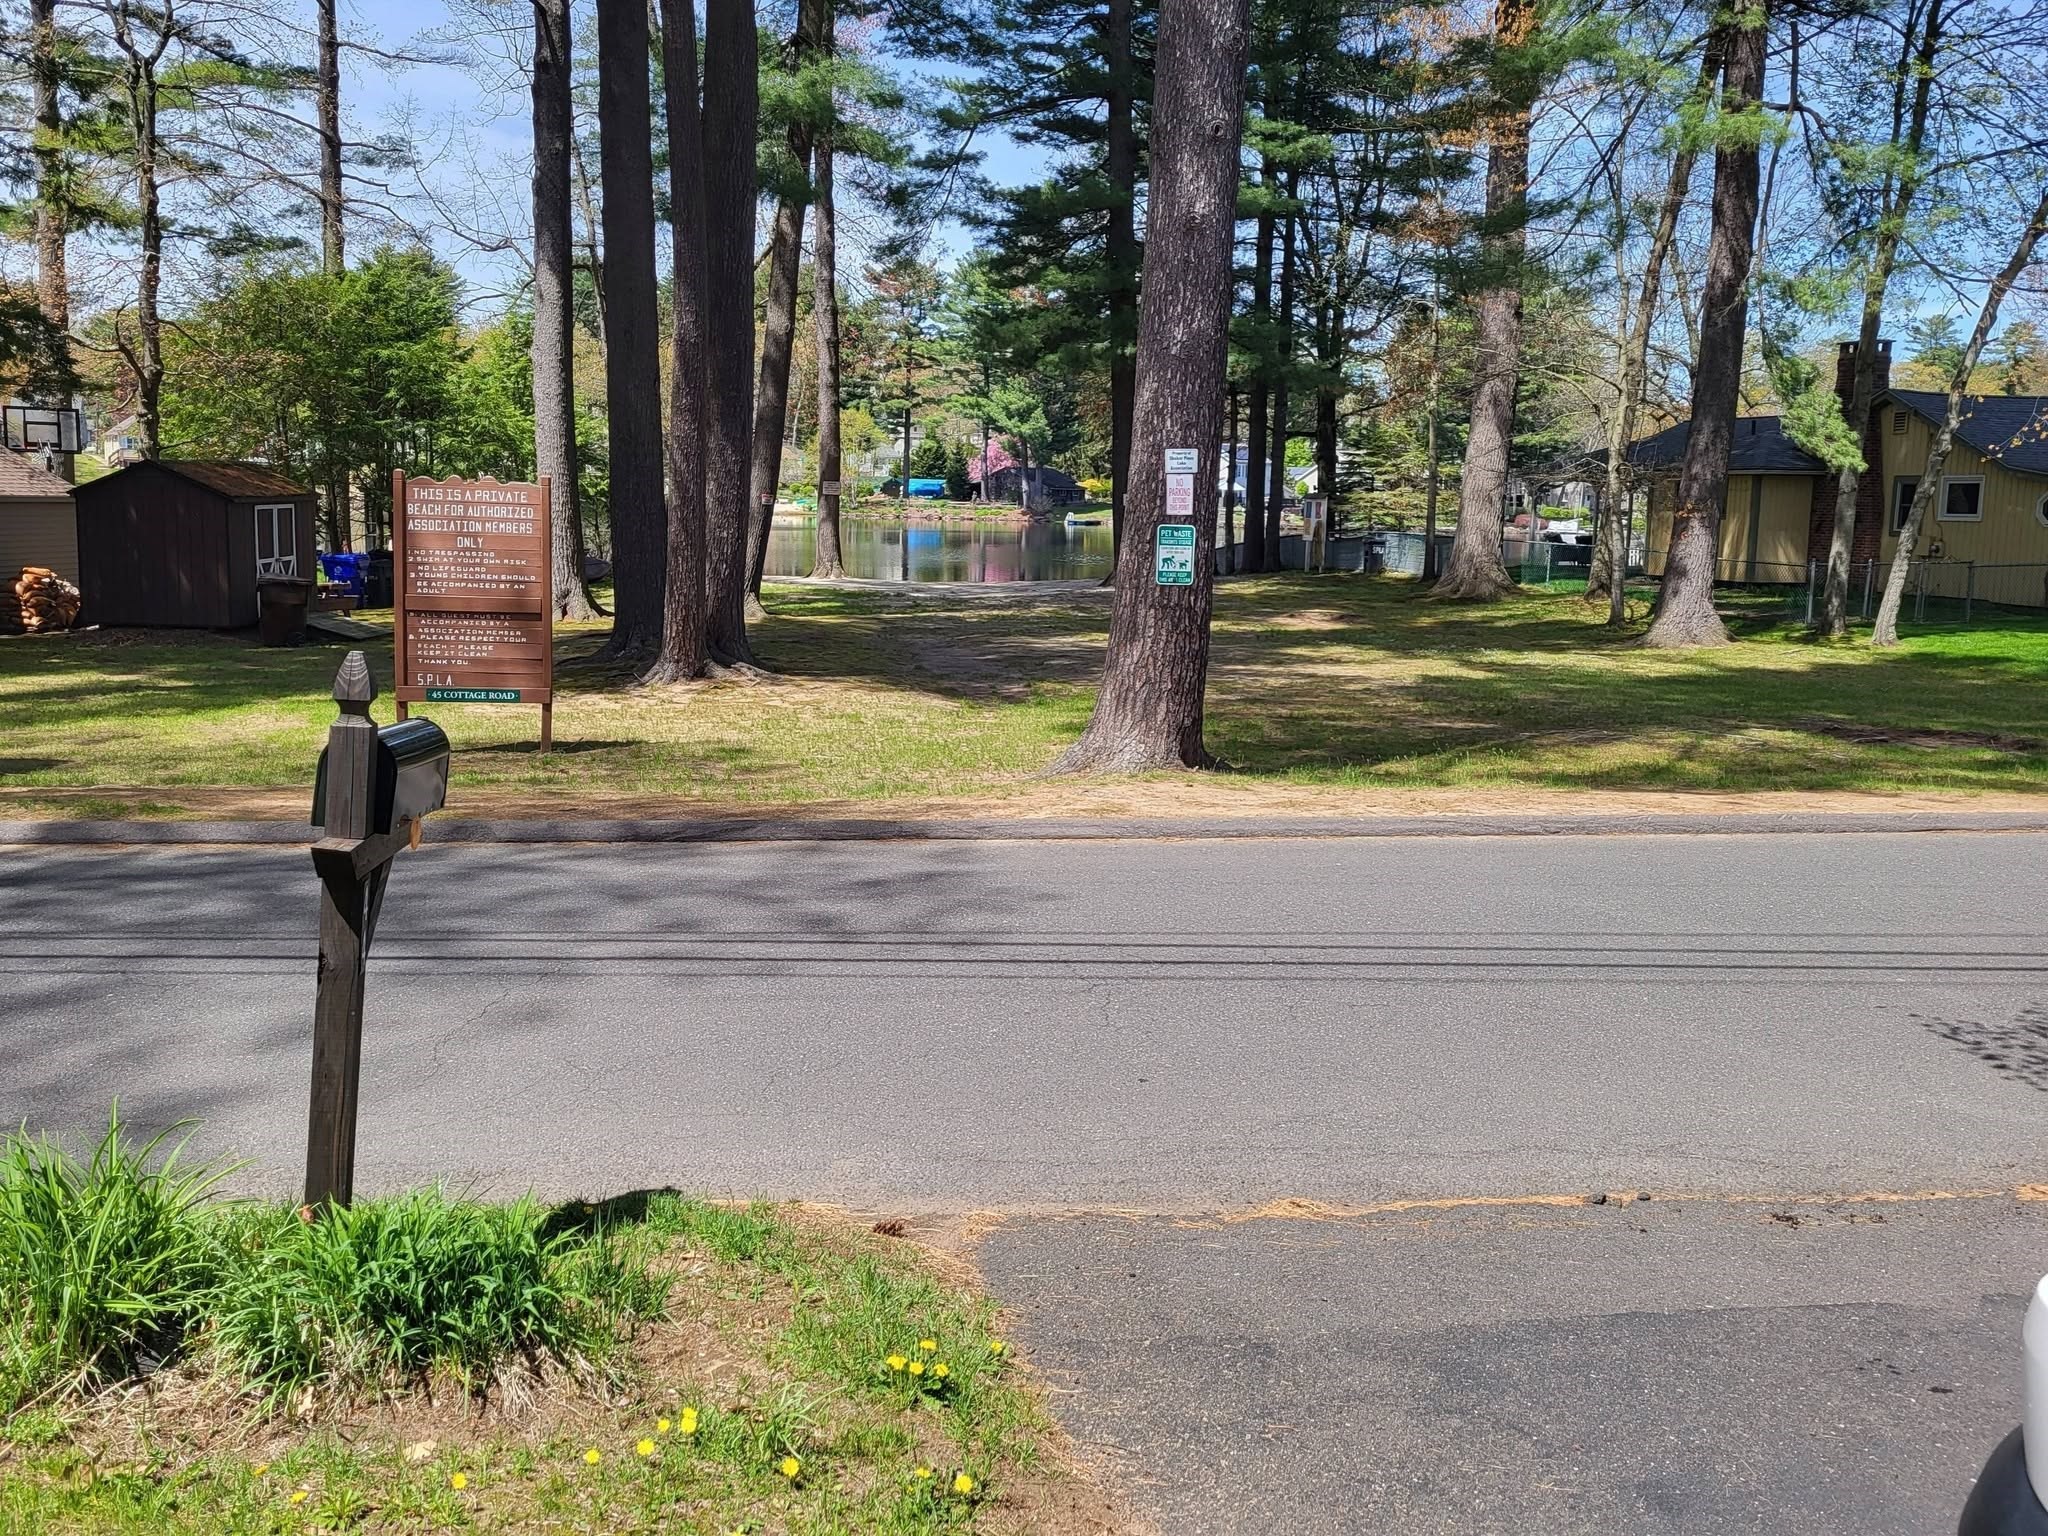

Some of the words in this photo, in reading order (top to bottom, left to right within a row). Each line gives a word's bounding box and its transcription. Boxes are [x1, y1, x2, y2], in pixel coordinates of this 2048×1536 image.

[1176, 478, 1184, 487] NO
[413, 488, 442, 500] THIS
[446, 489, 461, 500] IS
[465, 490, 472, 500] A
[475, 490, 528, 502] PRIVATE
[1168, 488, 1190, 496] PARKING
[408, 504, 440, 515] BEACH
[445, 505, 464, 516] FOR
[468, 506, 534, 518] AUTHORIZED
[408, 520, 482, 532] ASSOCIATION
[486, 522, 532, 534] MEMBERS
[457, 537, 484, 548] ONLY
[418, 674, 454, 686] S.P.L.A.
[432, 691, 442, 699] 45
[444, 691, 487, 700] COTTAGE
[488, 692, 514, 700] ROAD
